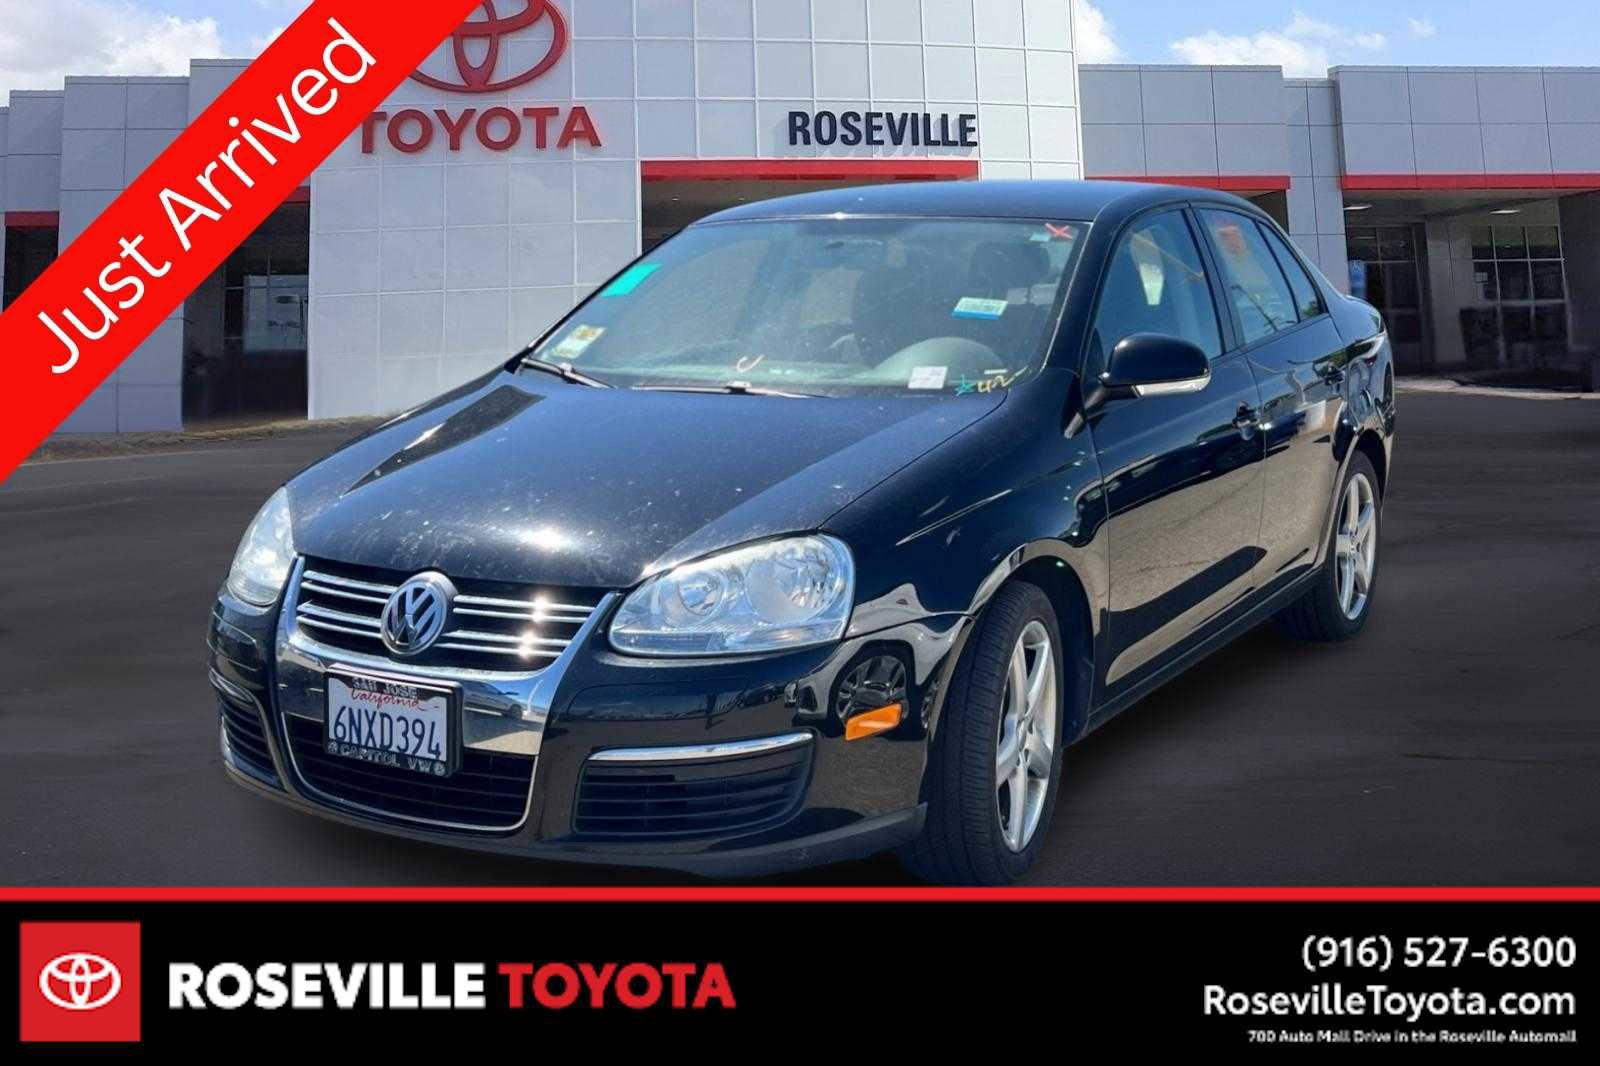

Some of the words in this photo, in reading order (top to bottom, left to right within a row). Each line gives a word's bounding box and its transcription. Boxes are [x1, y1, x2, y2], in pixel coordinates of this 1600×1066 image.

[361, 106, 603, 154] TOYOTA
[788, 110, 978, 147] ROSEVILLE
[333, 705, 441, 760] 6NXD394
